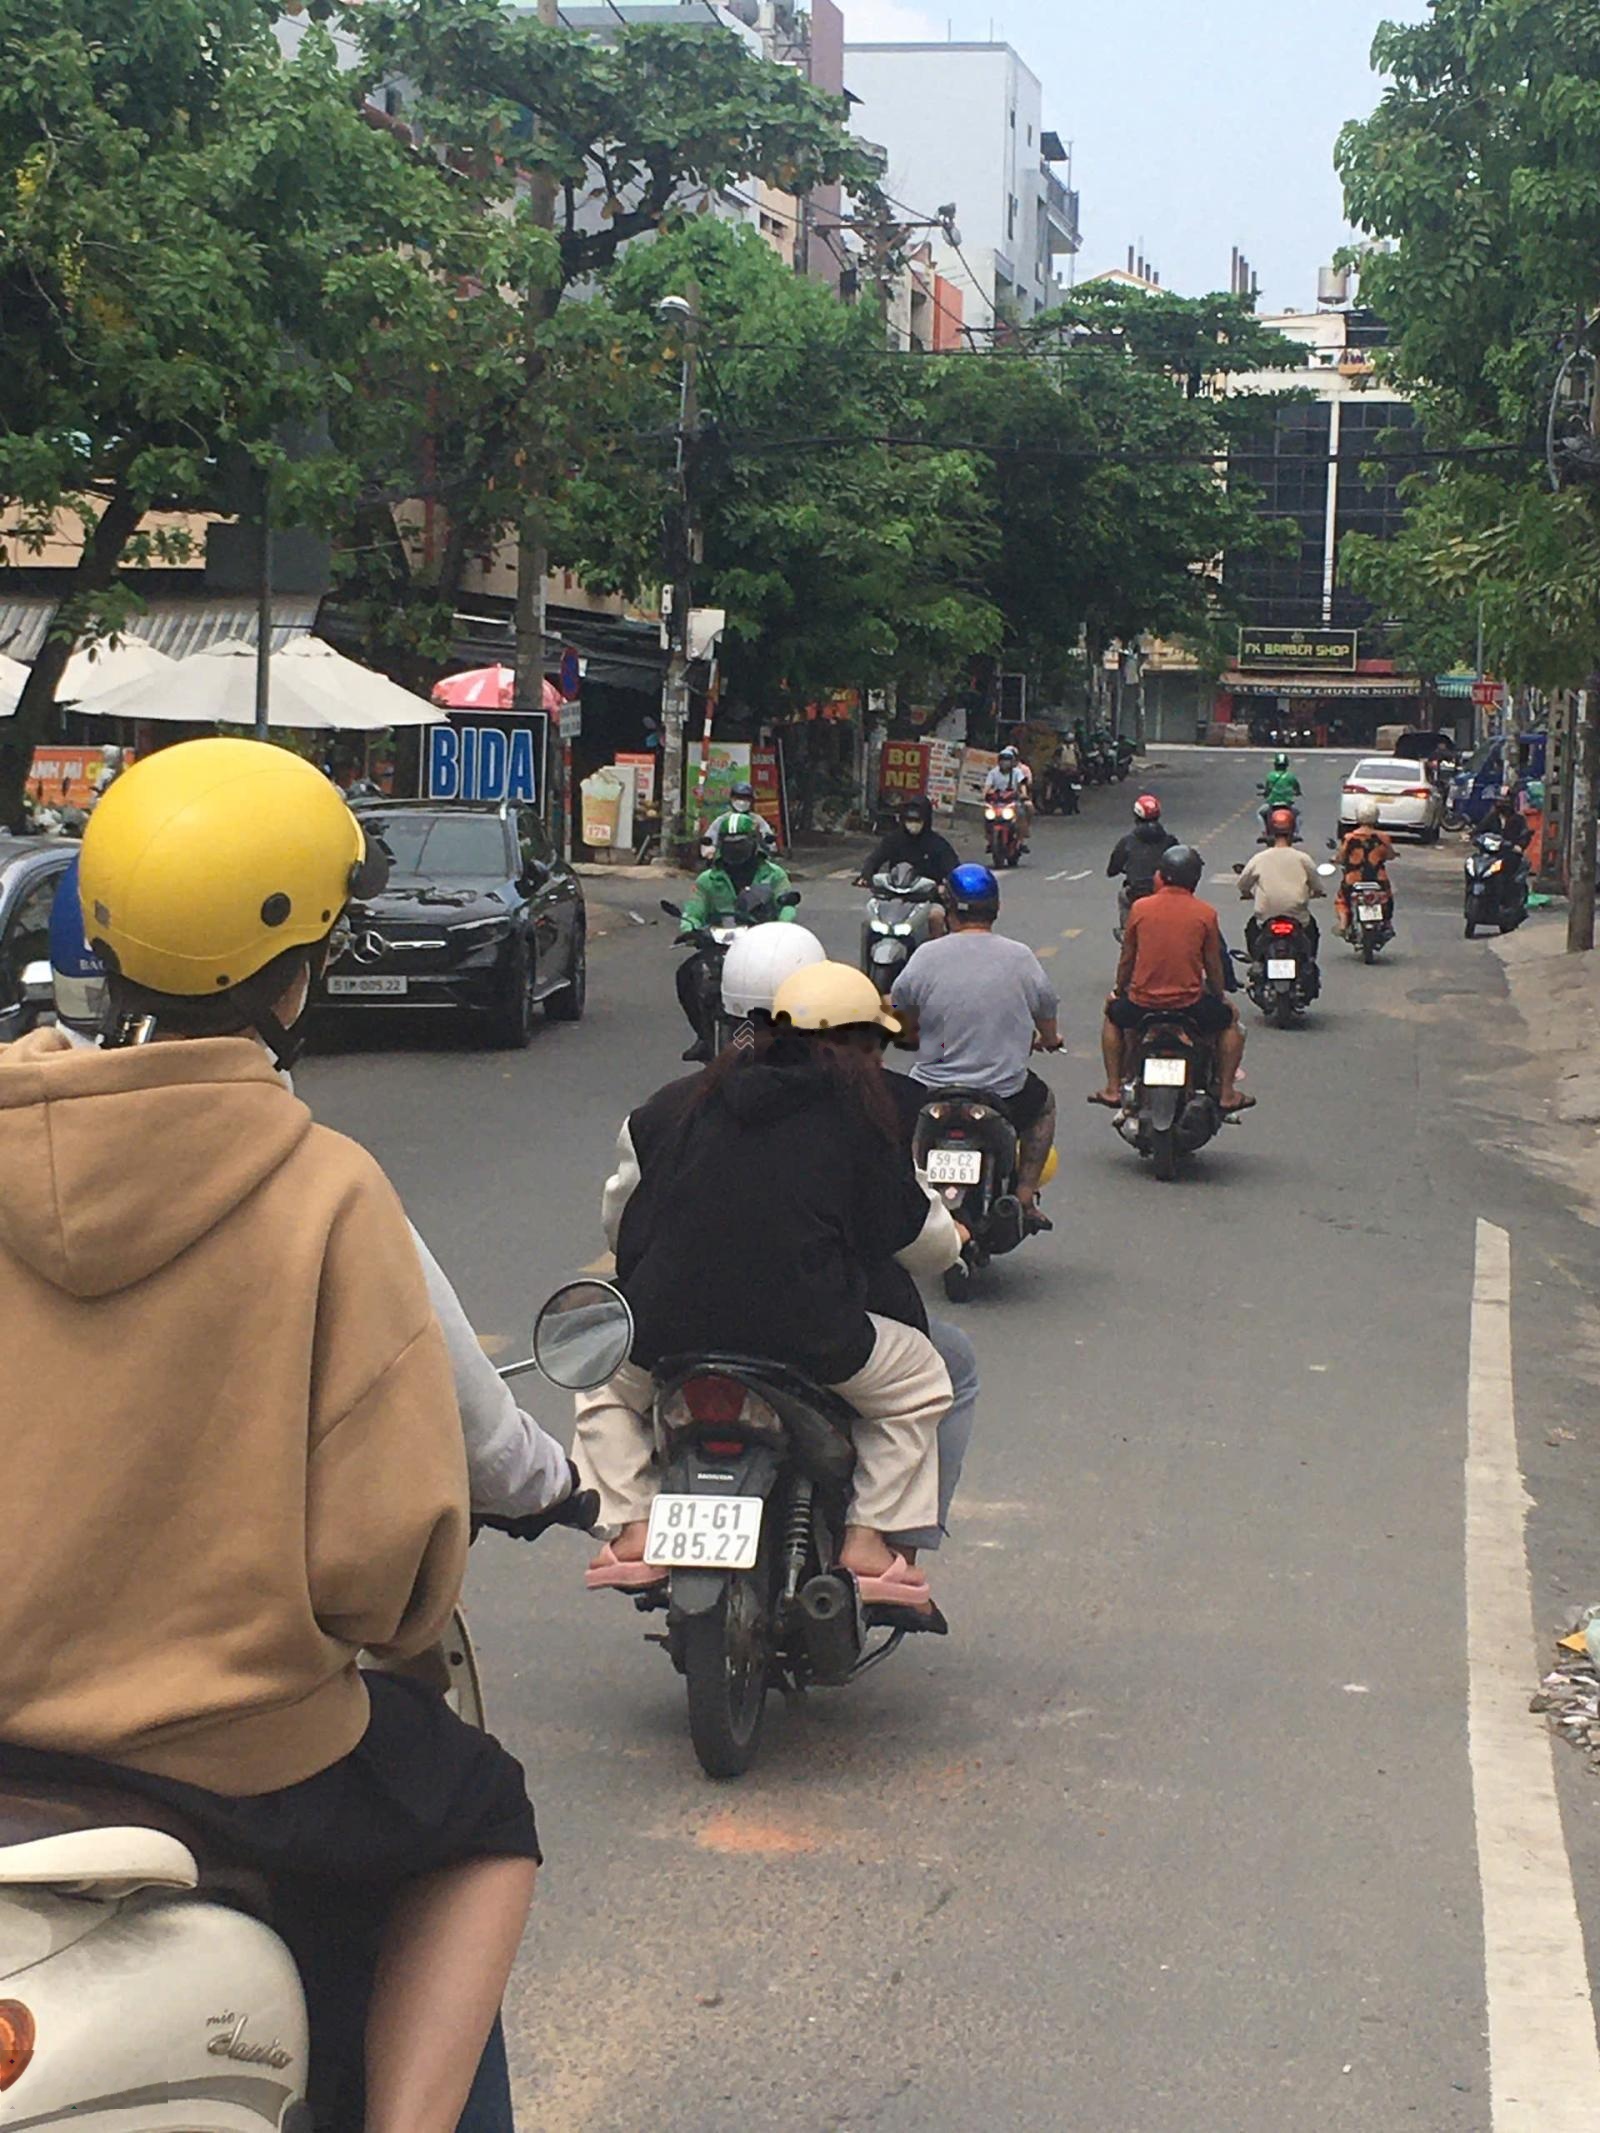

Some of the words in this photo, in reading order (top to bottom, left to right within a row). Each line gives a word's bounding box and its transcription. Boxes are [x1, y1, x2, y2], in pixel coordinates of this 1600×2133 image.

[1264, 643, 1313, 656] BARBER
[1315, 645, 1350, 656] SHOP
[429, 726, 536, 803] BIDA
[667, 1501, 743, 1530] 81-G1
[651, 1531, 751, 1562] 285.27
